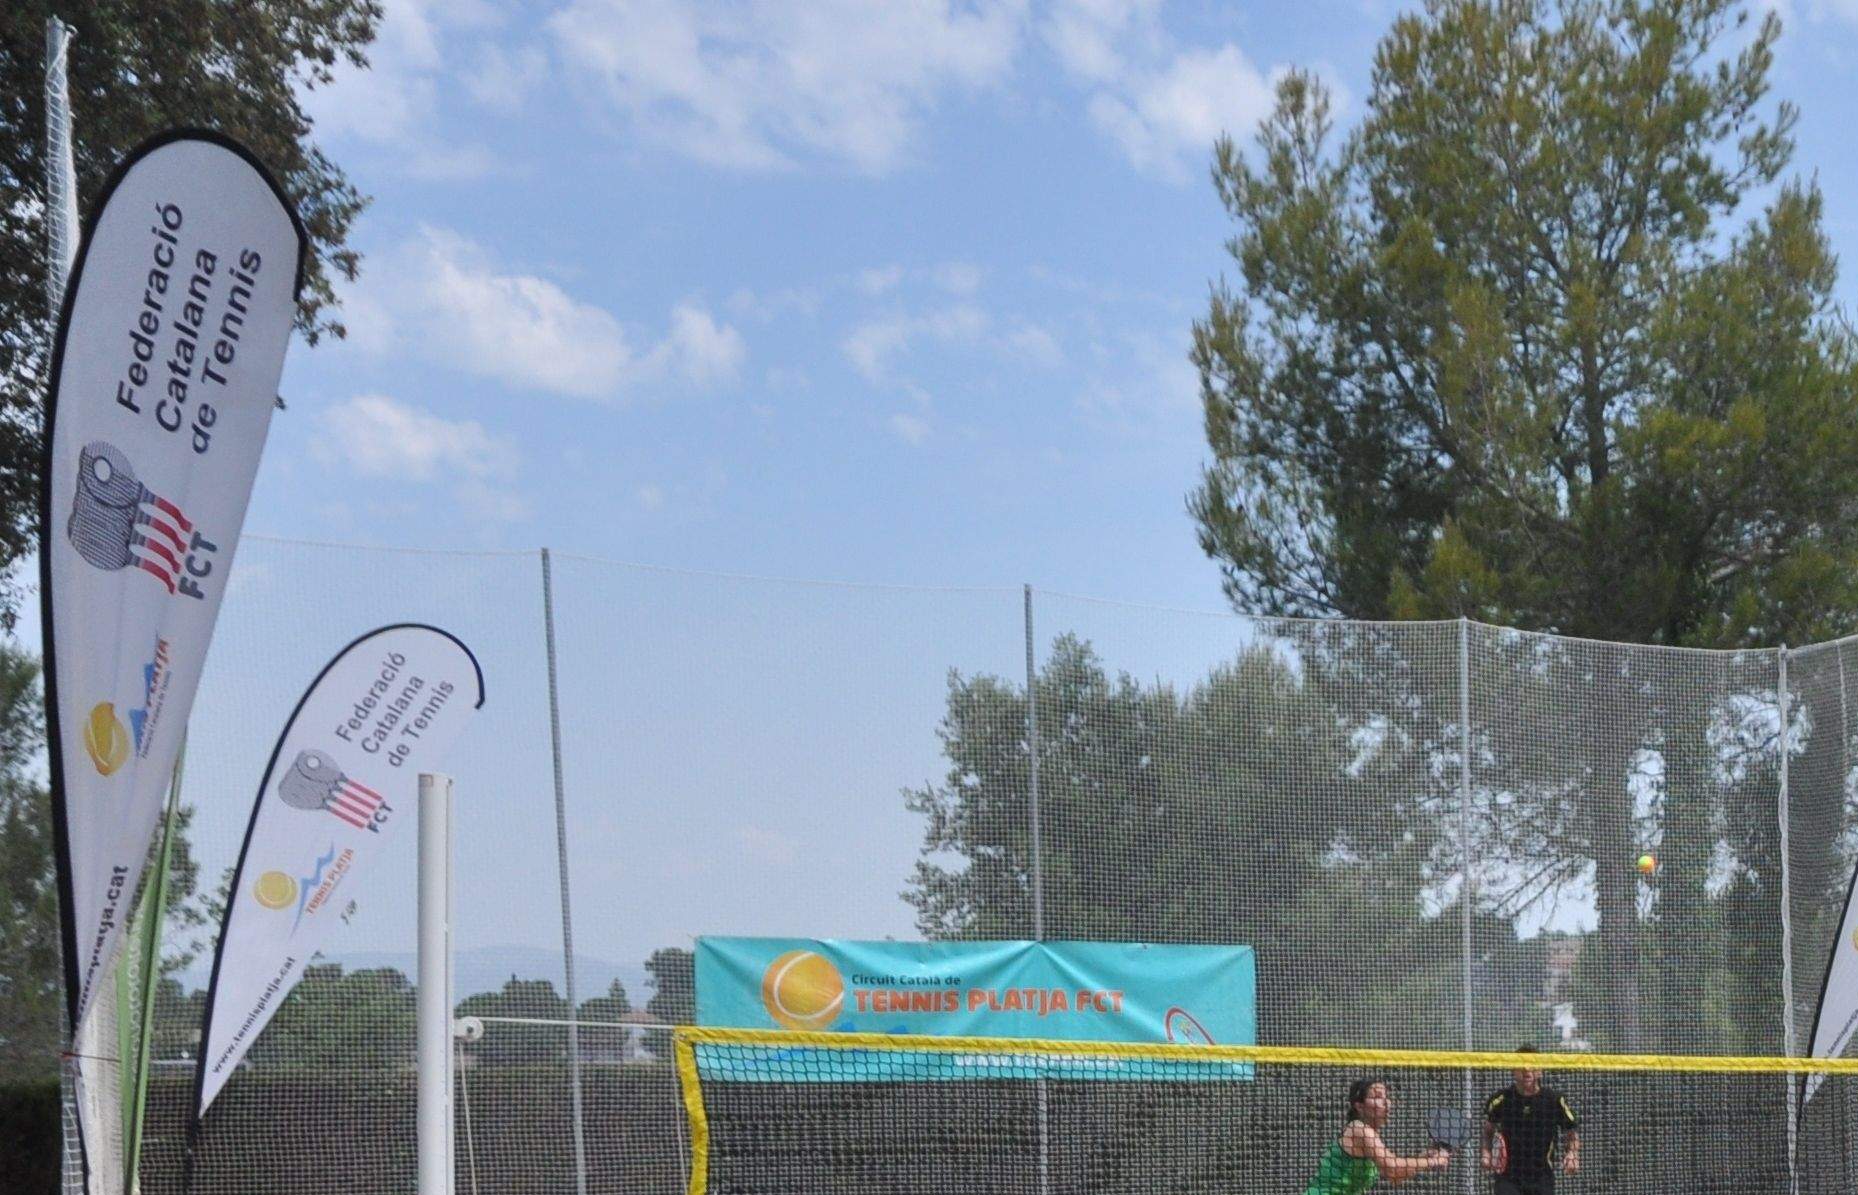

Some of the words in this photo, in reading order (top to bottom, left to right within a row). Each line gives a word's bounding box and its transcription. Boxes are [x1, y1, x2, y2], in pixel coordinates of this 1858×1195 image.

[116, 202, 184, 414] Federació
[155, 248, 219, 434] Catalana
[201, 249, 262, 386] Tennis
[193, 406, 219, 455] de
[179, 532, 220, 601] FCT
[335, 652, 406, 743] Federació
[361, 675, 425, 754] Catalana
[387, 743, 411, 768] de
[401, 680, 454, 741] Tennis
[367, 801, 393, 833] FCT
[211, 956, 296, 1073] www.tennisplatja.cat
[852, 973, 896, 986] Circuit
[945, 975, 961, 986] de
[853, 989, 962, 1014] TENNIS
[967, 988, 1069, 1016] PLATJA
[1075, 990, 1125, 1015] FCT
